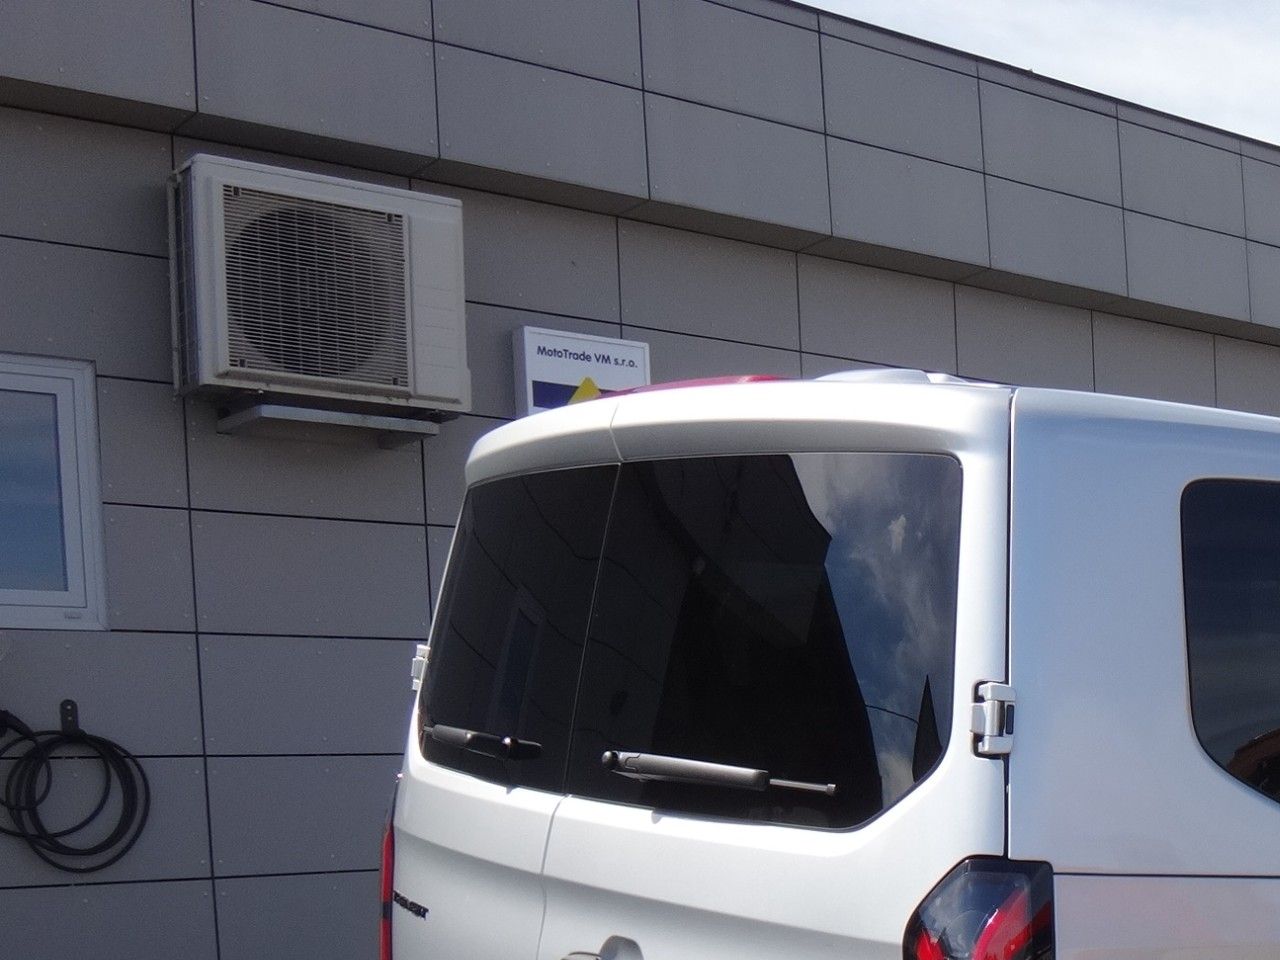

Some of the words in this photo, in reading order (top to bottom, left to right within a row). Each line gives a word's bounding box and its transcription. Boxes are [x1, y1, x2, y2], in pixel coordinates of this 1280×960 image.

[536, 345, 592, 362] MotoTrade
[594, 353, 611, 364] VM
[613, 357, 638, 369] s.r.o.
